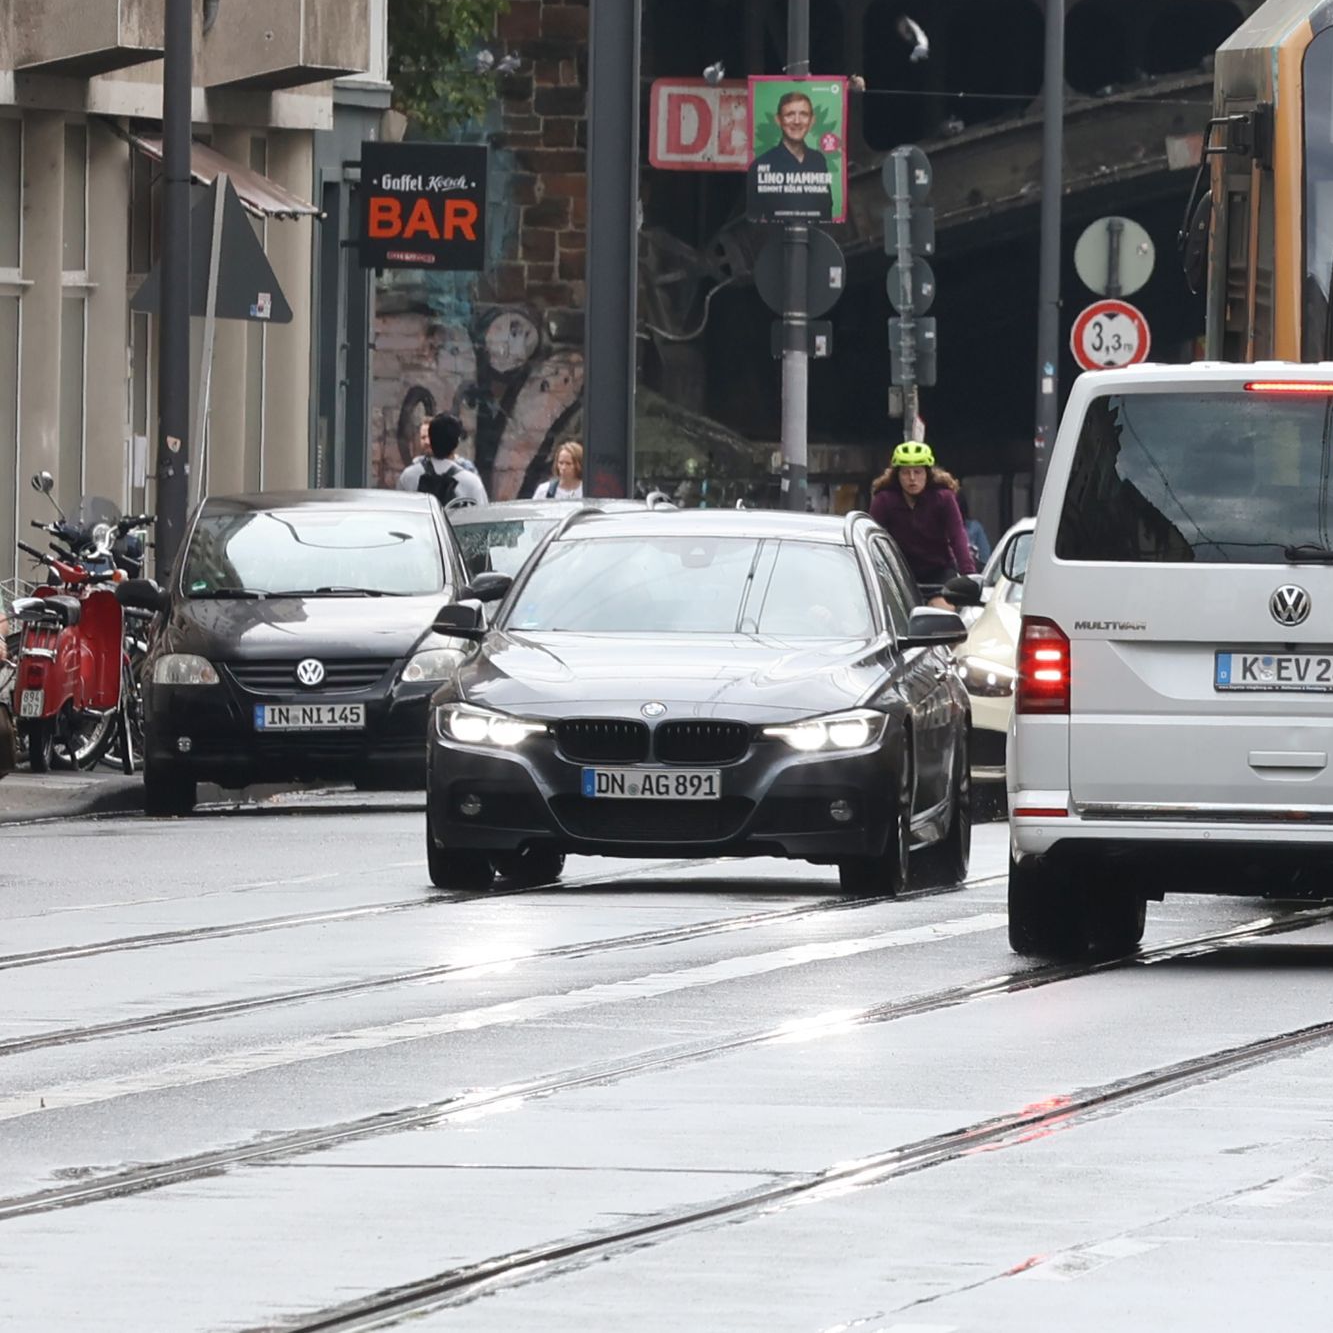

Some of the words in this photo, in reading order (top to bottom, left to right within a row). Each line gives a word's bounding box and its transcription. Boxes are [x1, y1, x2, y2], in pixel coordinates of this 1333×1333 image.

[382, 173, 422, 191] Gaffel
[758, 173, 784, 184] LINO
[786, 173, 832, 184] HAMMER
[368, 197, 478, 241] BAR
[1091, 321, 1122, 355] 3,3
[1074, 621, 1146, 631] MULTIVAN
[1242, 657, 1259, 681] K
[1277, 658, 1311, 682] EV
[269, 708, 290, 725] IN
[302, 707, 324, 725] NI
[327, 706, 361, 724] 145
[597, 773, 625, 794] DN
[641, 774, 670, 796] AG
[675, 775, 717, 797] 891
